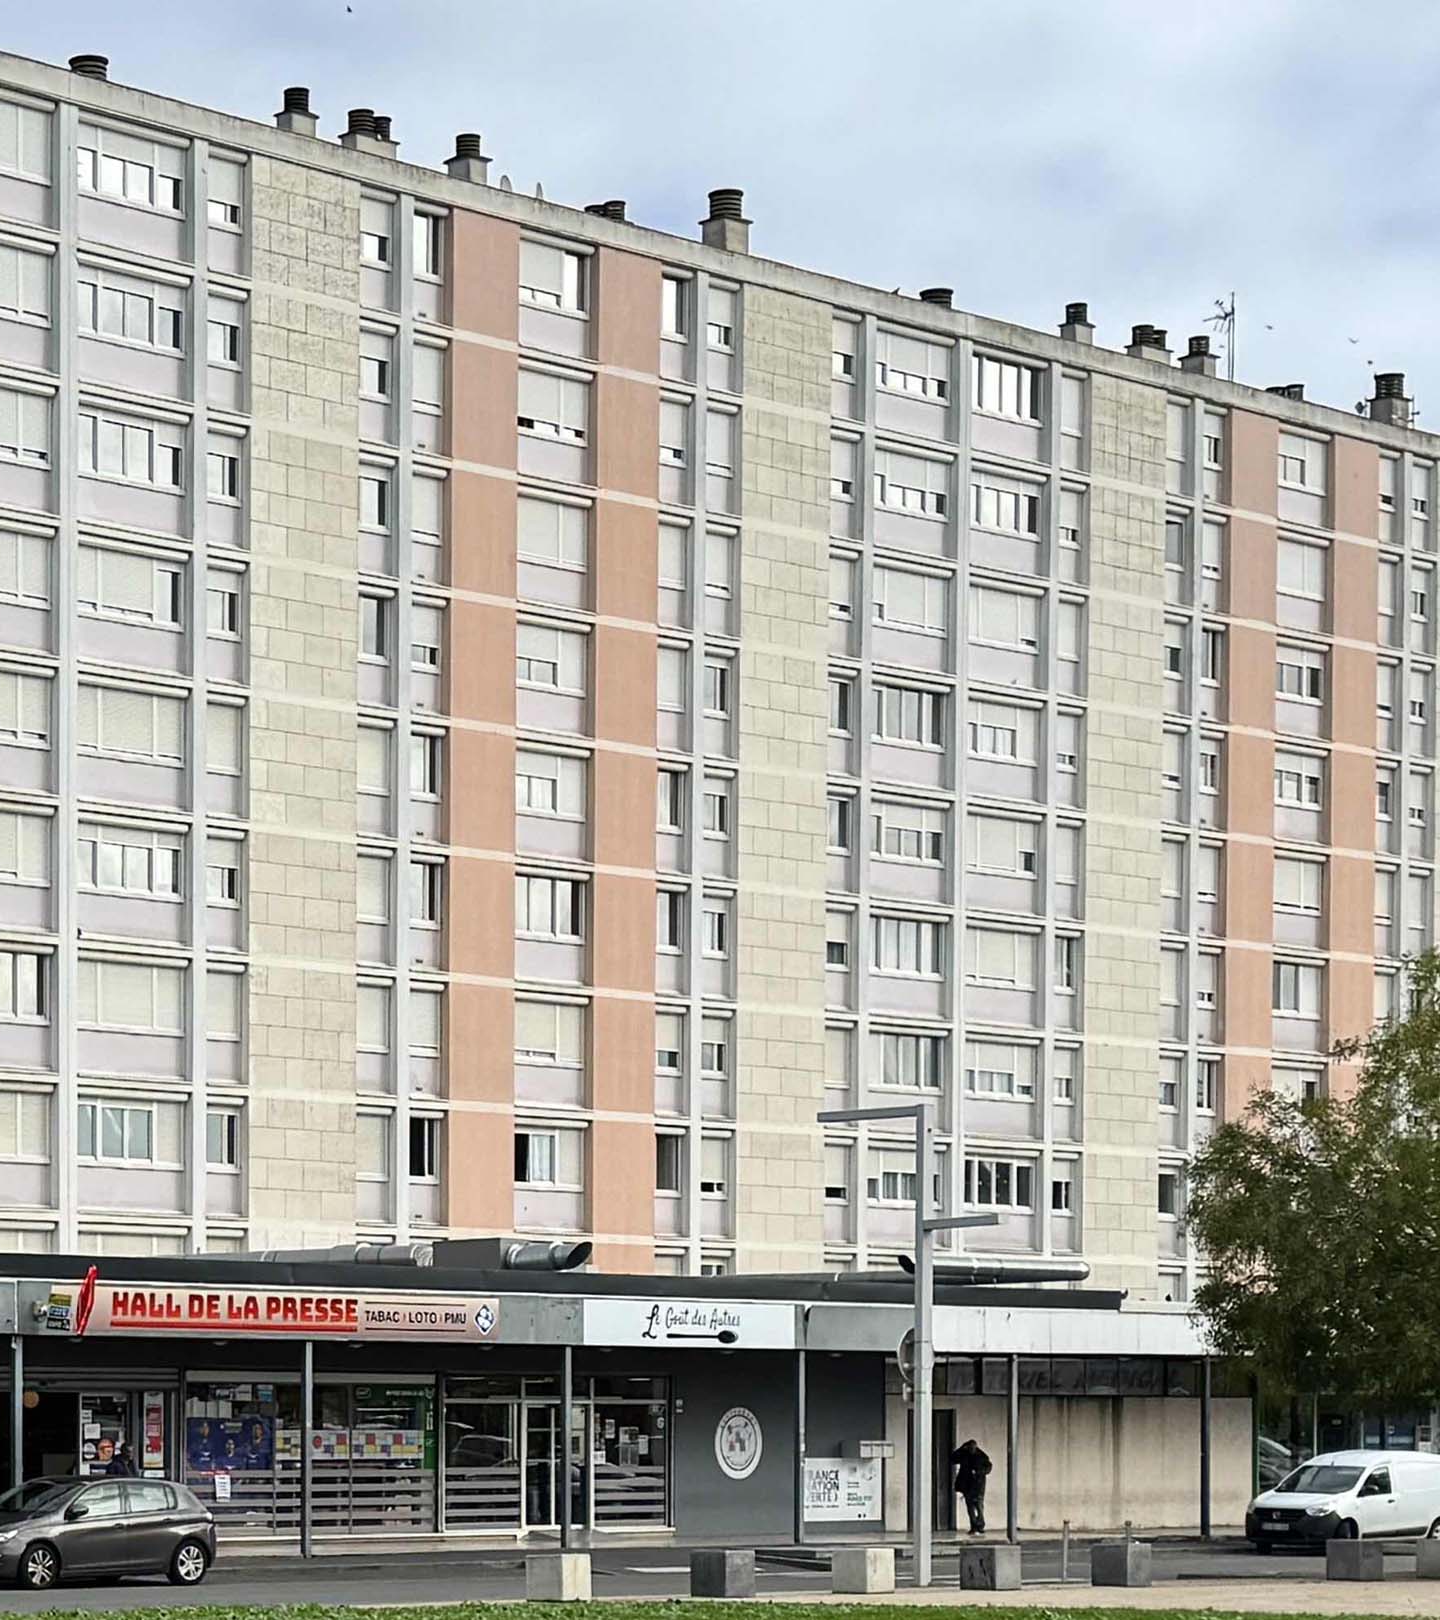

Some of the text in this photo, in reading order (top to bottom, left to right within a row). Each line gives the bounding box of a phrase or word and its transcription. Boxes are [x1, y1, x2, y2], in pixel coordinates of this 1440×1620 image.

[112, 1291, 358, 1323] HALL DE LA PRESSE
[365, 1310, 467, 1325] TABAC LOTO PMU
